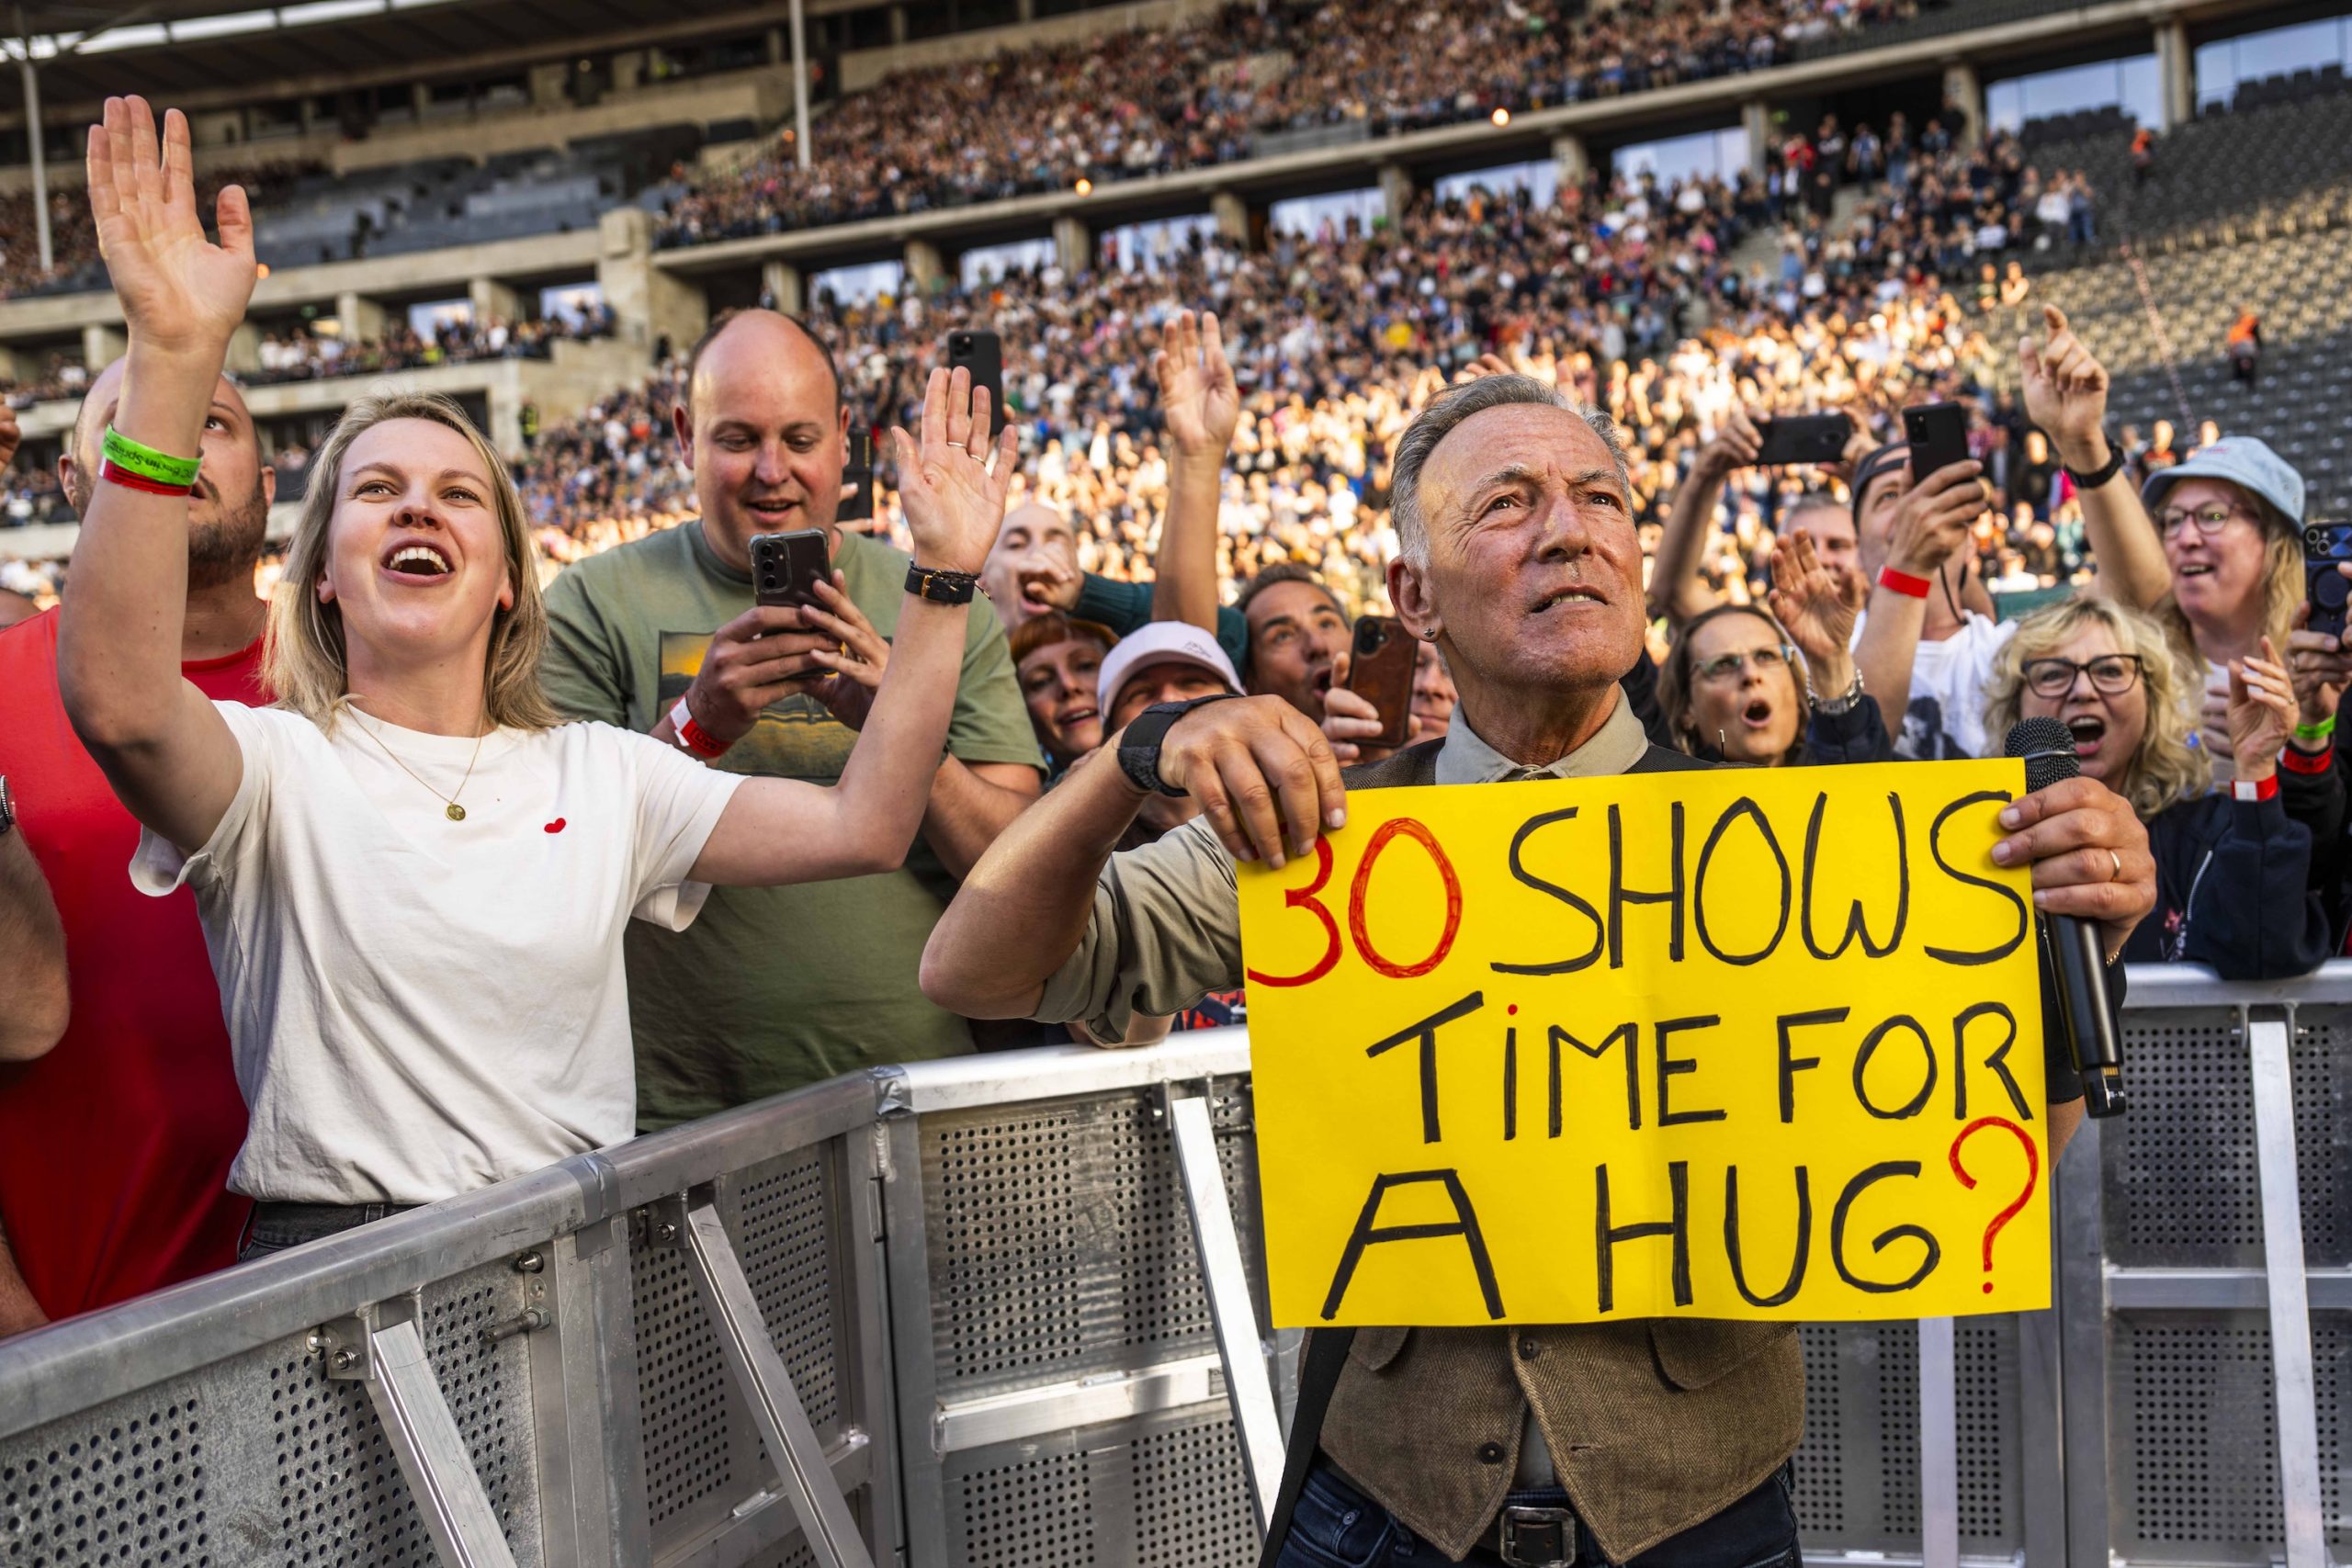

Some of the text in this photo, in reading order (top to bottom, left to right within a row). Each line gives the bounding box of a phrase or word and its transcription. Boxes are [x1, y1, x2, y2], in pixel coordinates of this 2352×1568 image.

[1248, 790, 2027, 987] 30 SHOWS
[1778, 1001, 2033, 1122] FOR
[1320, 1116, 2039, 1320] A HUG?
